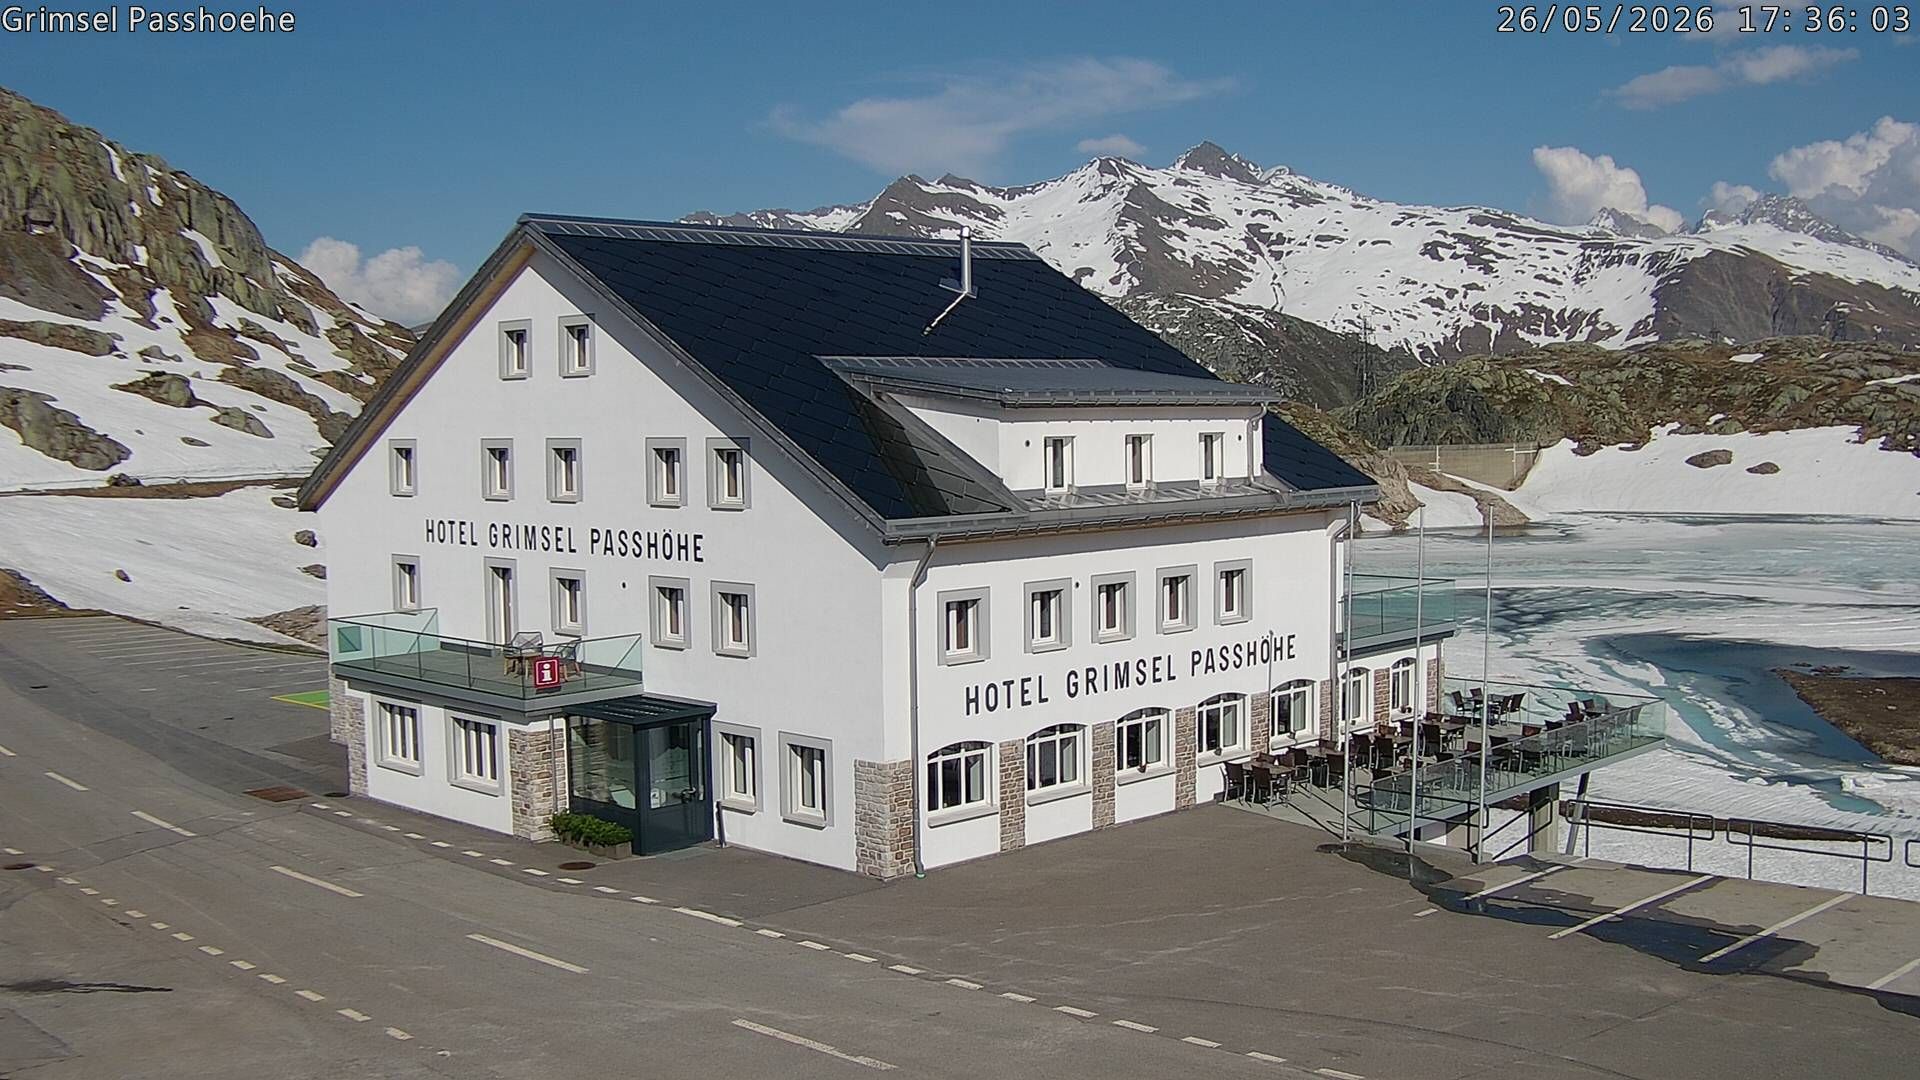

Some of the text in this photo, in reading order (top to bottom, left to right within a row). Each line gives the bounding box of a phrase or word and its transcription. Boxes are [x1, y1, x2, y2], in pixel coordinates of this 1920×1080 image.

[425, 519, 704, 563] HOTEL GRIMSEL PASSHÖHE
[965, 633, 1297, 716] HOTEL GRIMSEL PASSHÖHE
